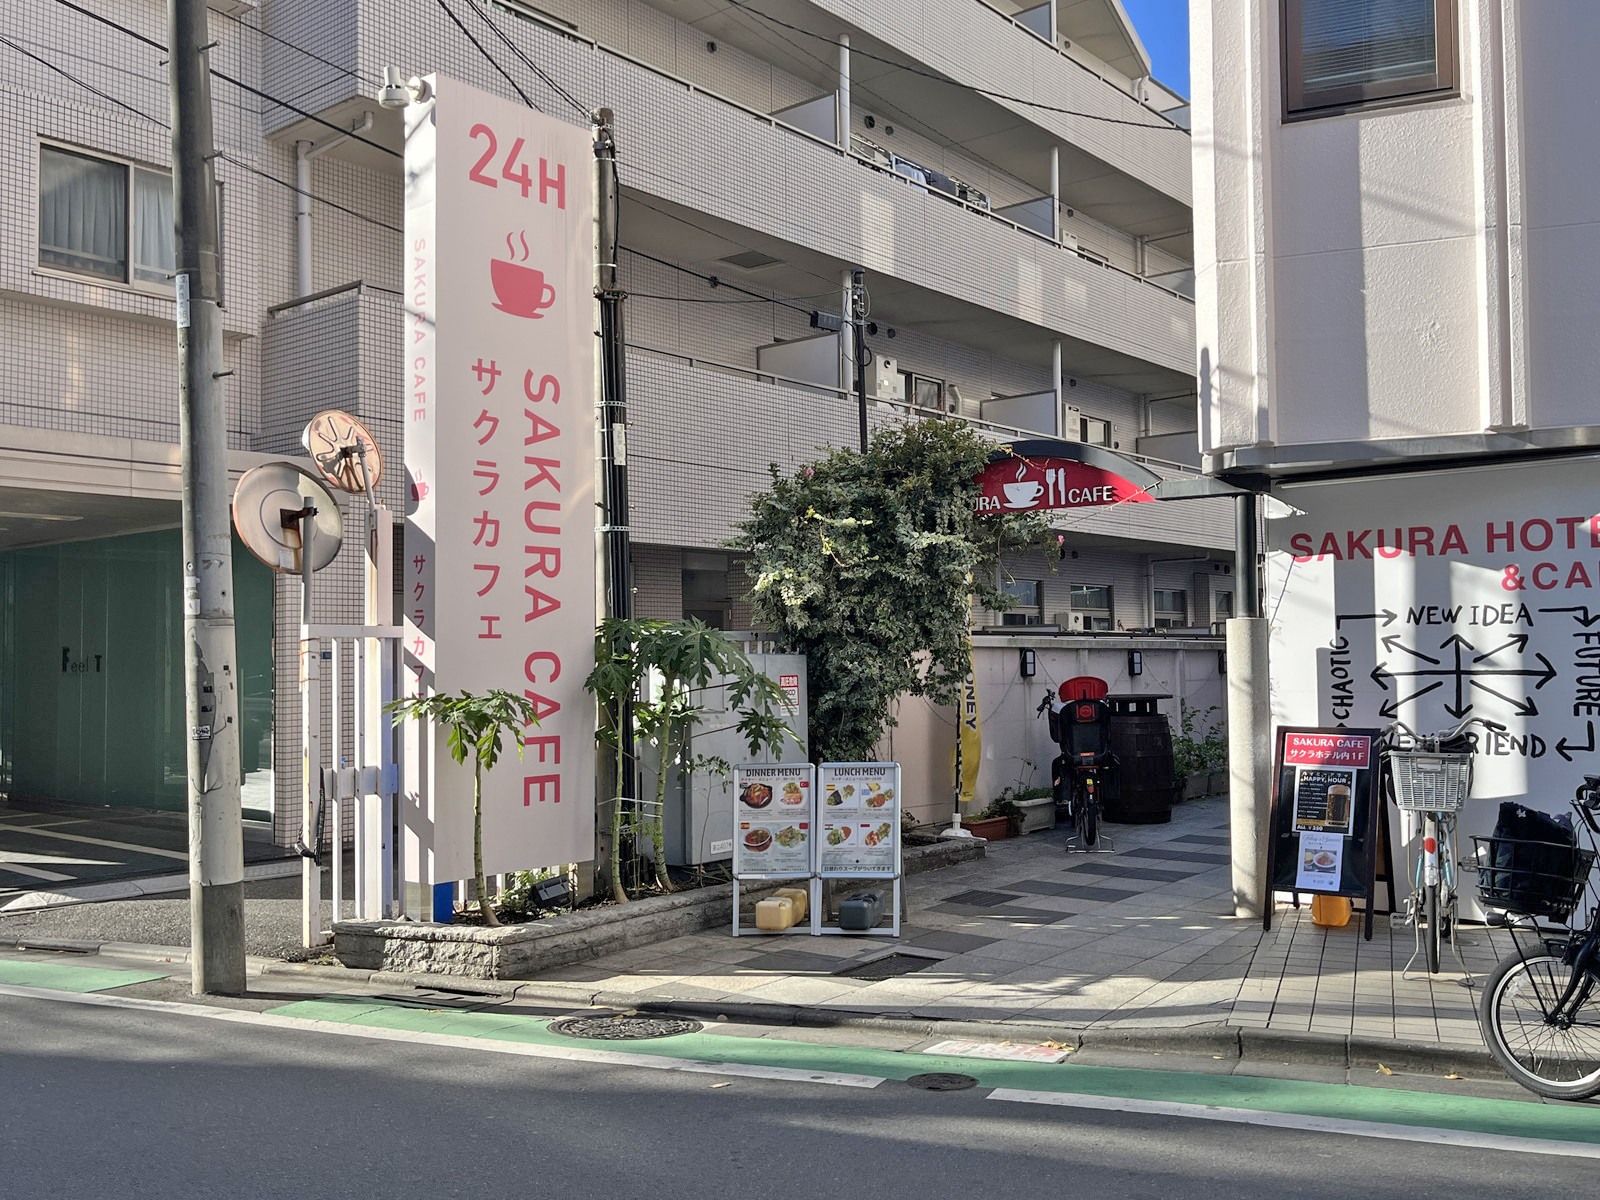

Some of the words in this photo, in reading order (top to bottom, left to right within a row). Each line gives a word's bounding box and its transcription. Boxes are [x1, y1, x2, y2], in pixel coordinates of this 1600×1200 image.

[469, 123, 566, 210] 24H
[413, 238, 426, 345] SAKURA
[413, 356, 426, 422] CAFE
[472, 358, 502, 639] サクラカフェ
[524, 368, 561, 623] SAKURA
[1068, 485, 1113, 504] CAFE
[1290, 524, 1469, 563] SAKURA
[1501, 561, 1600, 591] &CA
[1406, 605, 1463, 626] NEW
[1469, 603, 1534, 627] IDEA
[1329, 633, 1355, 720] CHAOTIC
[1572, 631, 1600, 717] FUTURE
[523, 651, 561, 807] CAFE
[1293, 737, 1334, 747] SAKURA
[1337, 739, 1364, 749] CAFE
[1465, 731, 1547, 758] RIEND
[746, 768, 776, 777] DINNER
[777, 768, 801, 777] MENU
[834, 768, 860, 777] LUNCH
[862, 768, 886, 776] MENU
